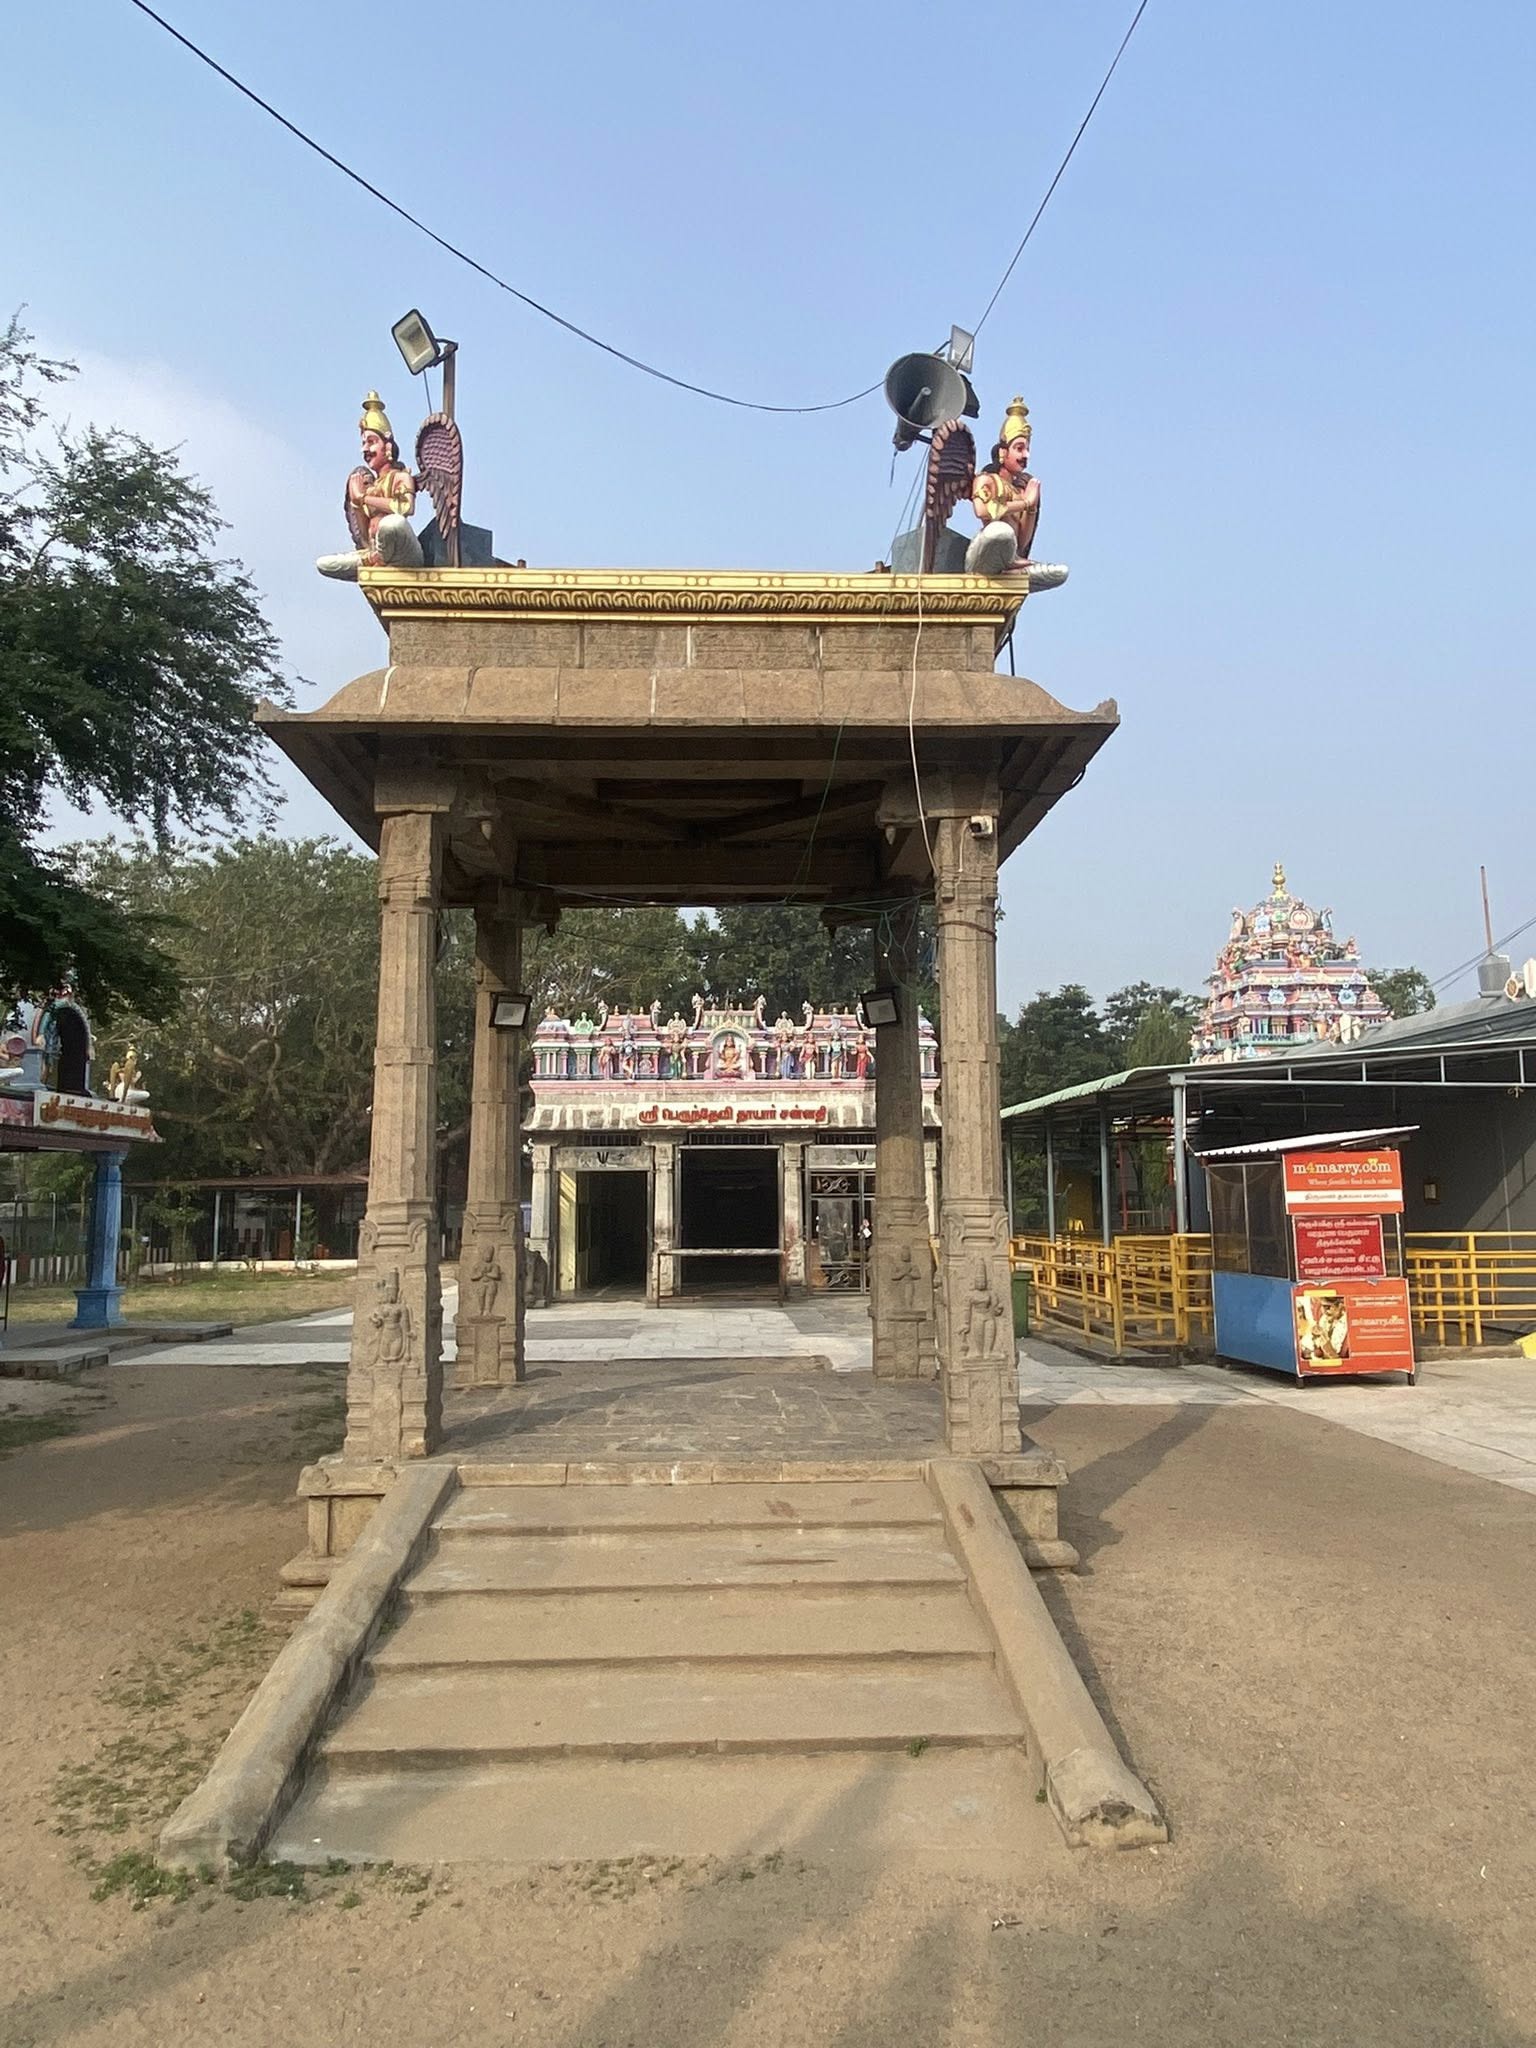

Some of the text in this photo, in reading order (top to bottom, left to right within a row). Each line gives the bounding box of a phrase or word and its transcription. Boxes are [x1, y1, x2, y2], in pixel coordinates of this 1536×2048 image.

[639, 1105, 659, 1124] ஸ்ரீ
[662, 1104, 733, 1123] பெருந்தேவி
[736, 1104, 776, 1124] தாயார்
[1292, 1158, 1392, 1176] m4marry.com
